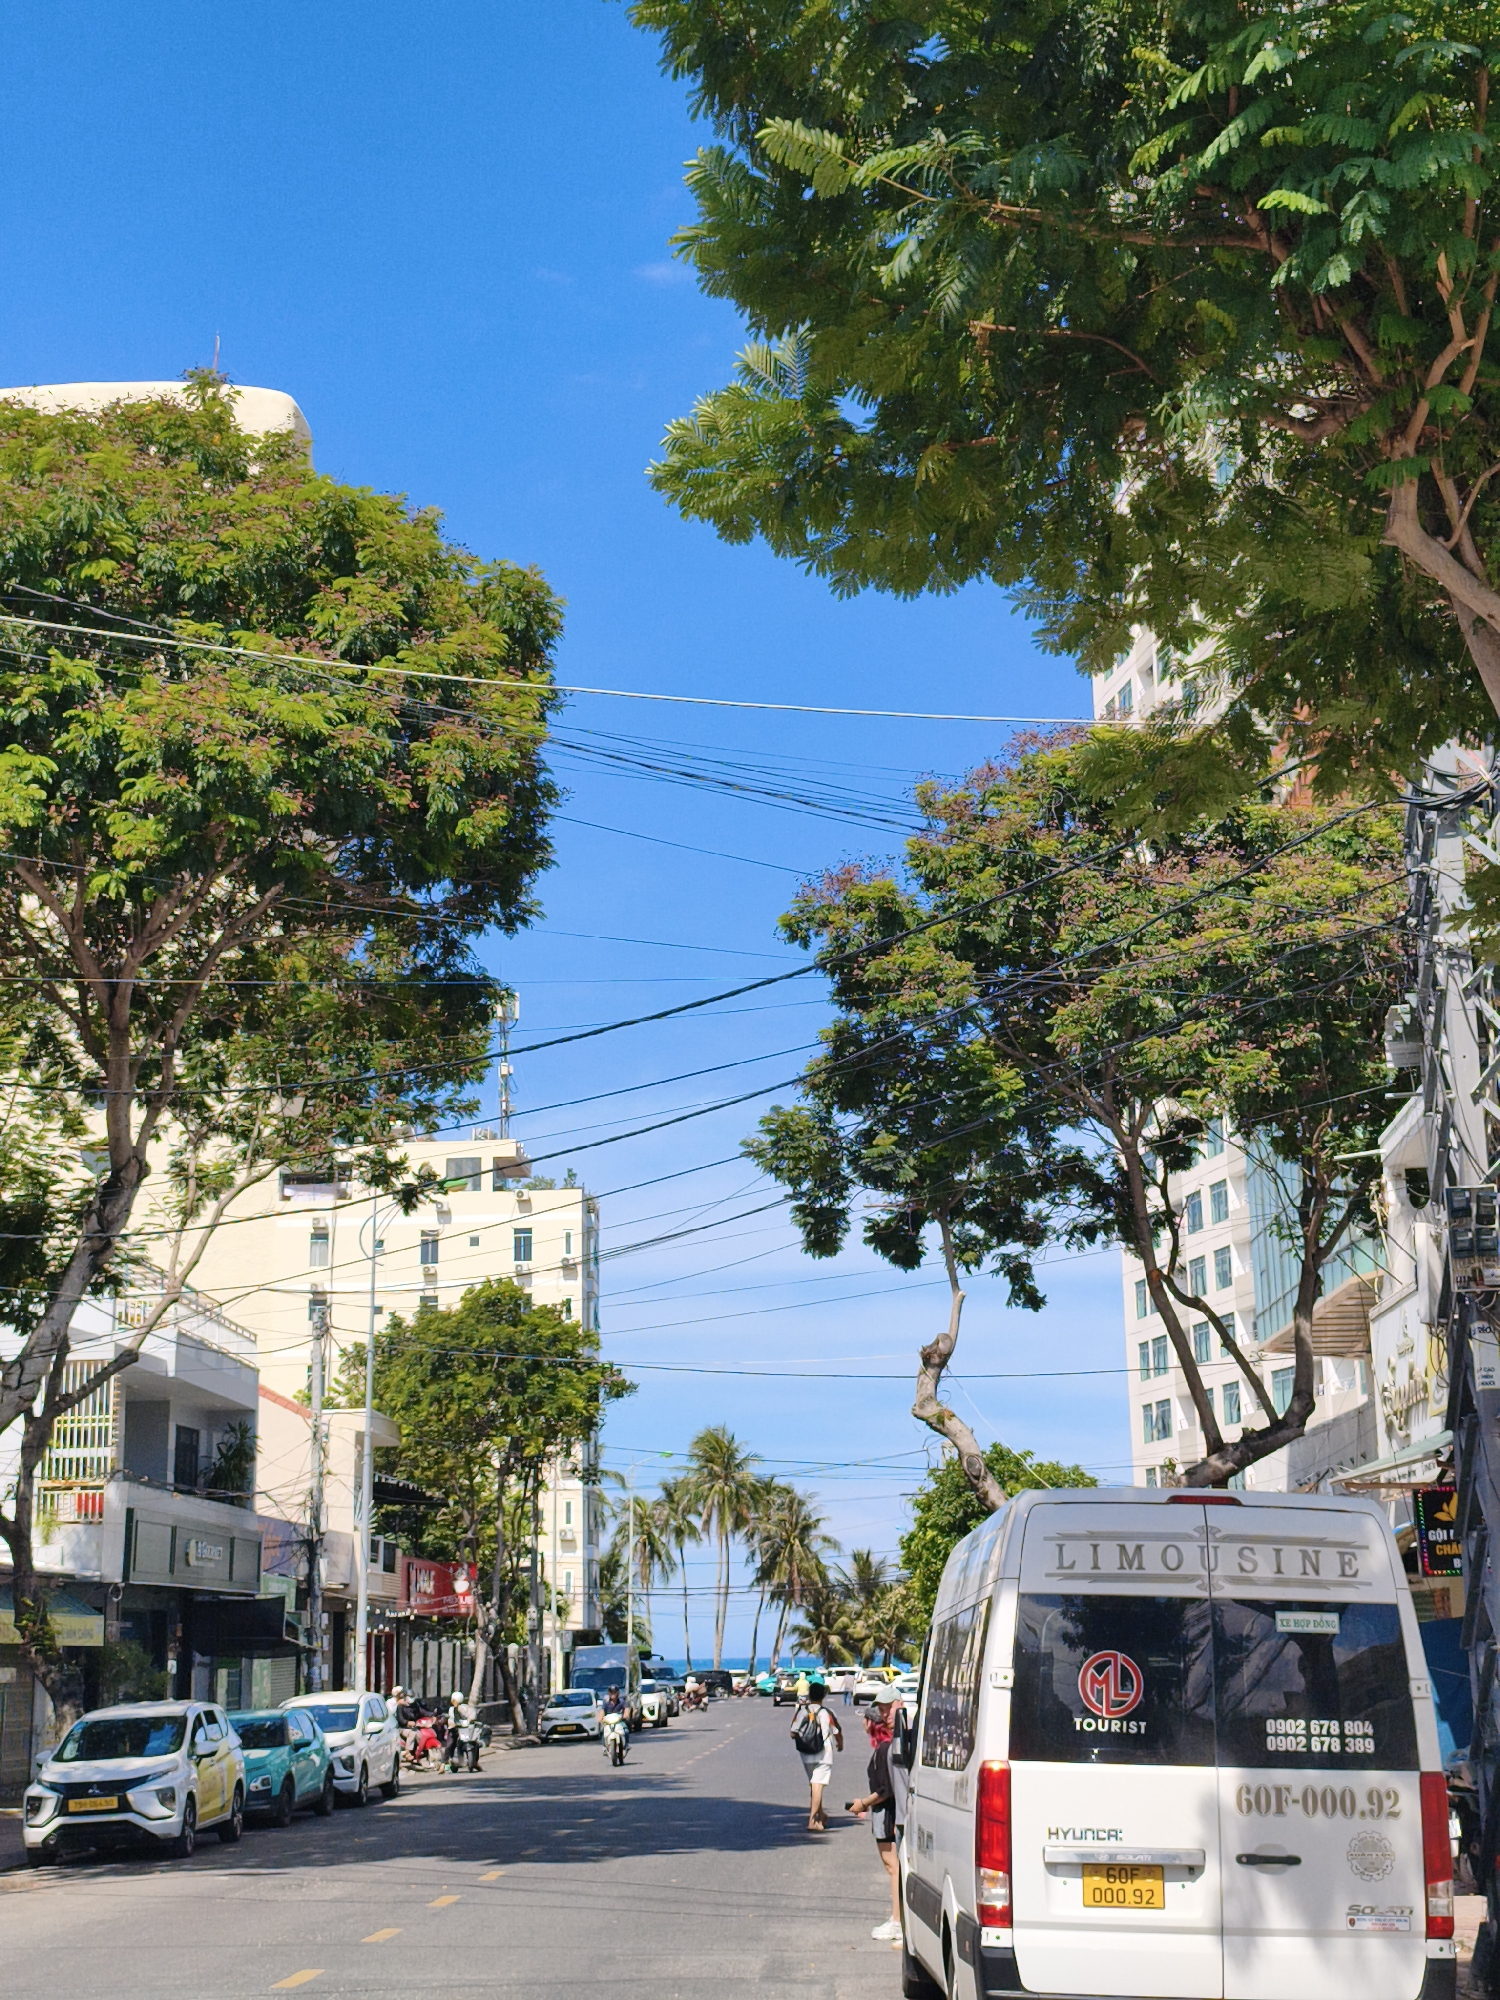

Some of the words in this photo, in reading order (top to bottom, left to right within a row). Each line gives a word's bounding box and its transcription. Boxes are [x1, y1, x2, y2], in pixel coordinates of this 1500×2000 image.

[1055, 1543, 1359, 1578] LIMOUSINE
[1279, 1619, 1291, 1628] XE
[1074, 1717, 1146, 1734] TOURIST
[1266, 1719, 1307, 1735] 0902
[1310, 1720, 1340, 1735] 678
[1344, 1721, 1374, 1736] 804
[1266, 1735, 1307, 1752] 0902
[1310, 1736, 1341, 1753] 678
[1345, 1738, 1375, 1753] 389
[1236, 1783, 1402, 1820] 60F-000.92
[1106, 1867, 1140, 1885] 60F
[1093, 1887, 1155, 1905] 000.92
